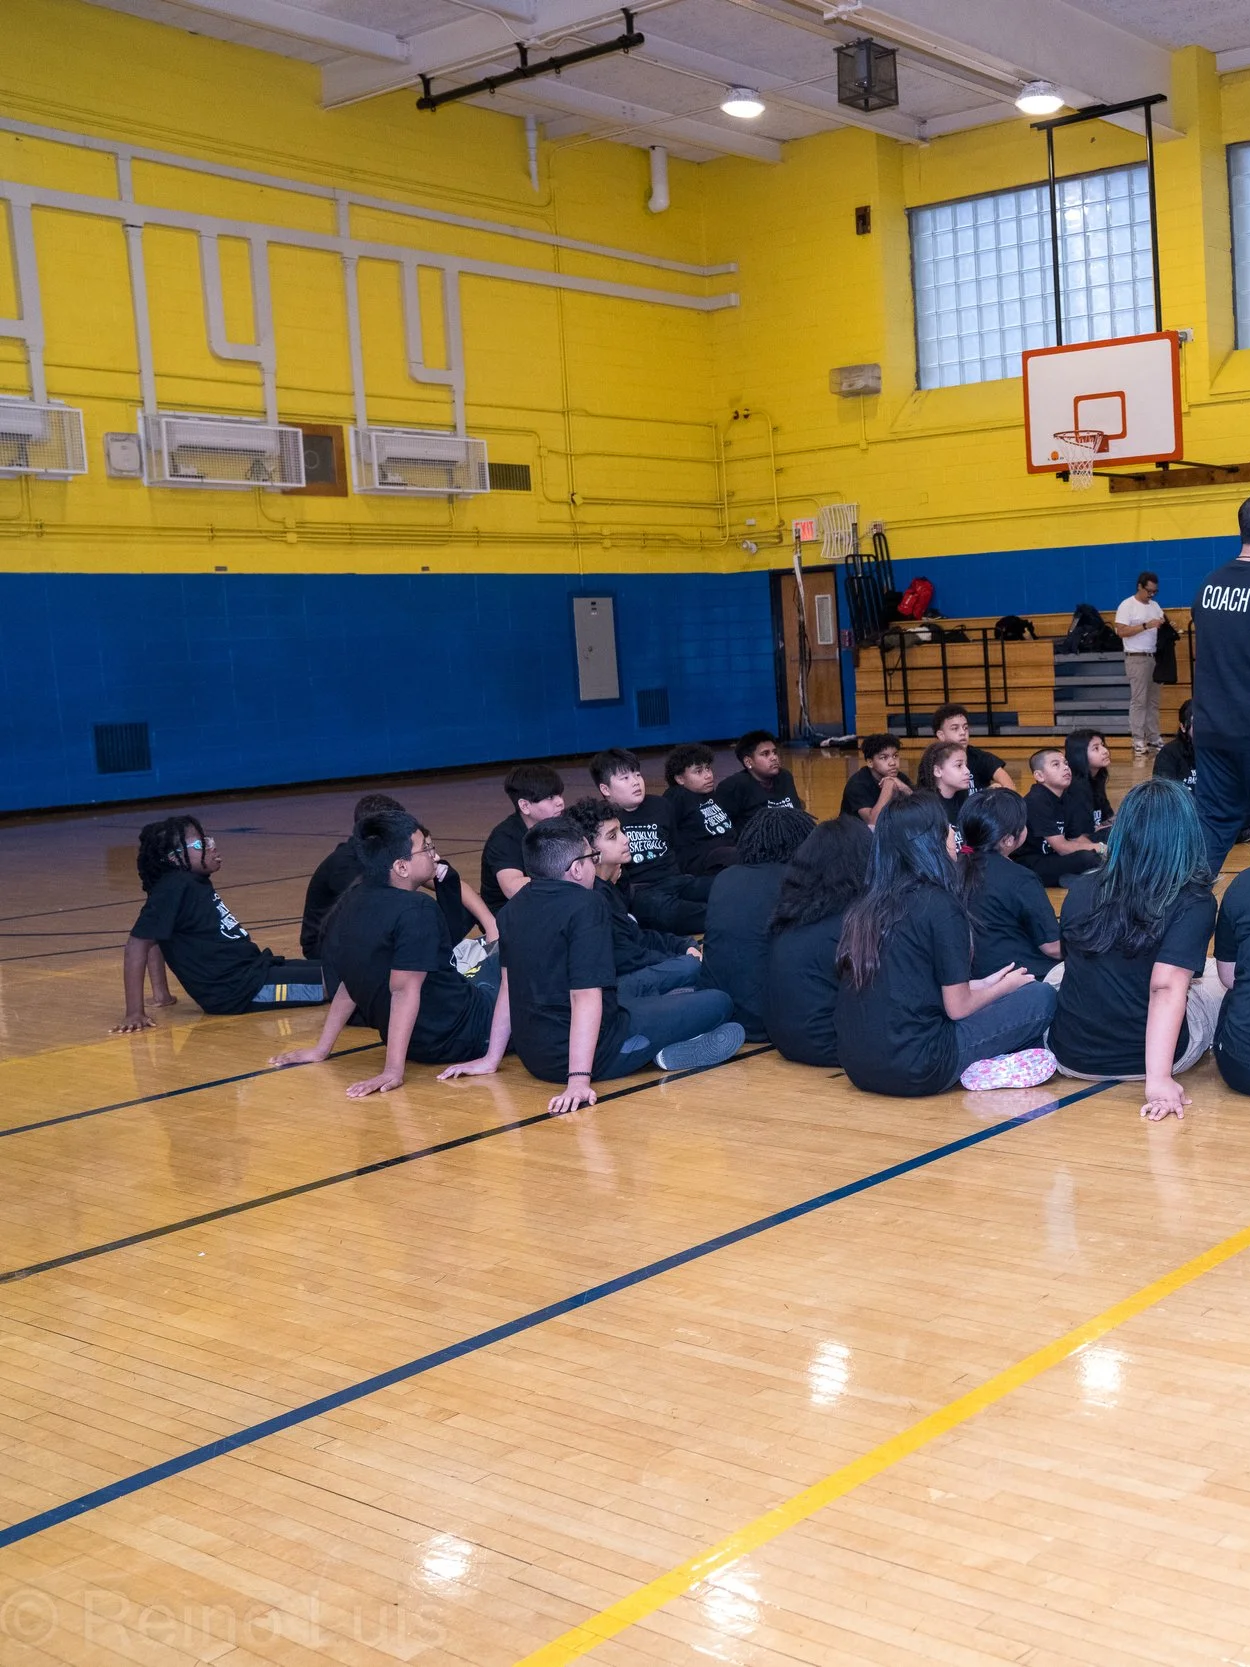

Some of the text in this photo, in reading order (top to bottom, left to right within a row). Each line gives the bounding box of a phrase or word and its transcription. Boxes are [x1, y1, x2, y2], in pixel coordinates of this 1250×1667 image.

[1202, 585, 1250, 612] COACH
[627, 831, 659, 841] ROOKLYN
[630, 840, 662, 852] SKETBALL
